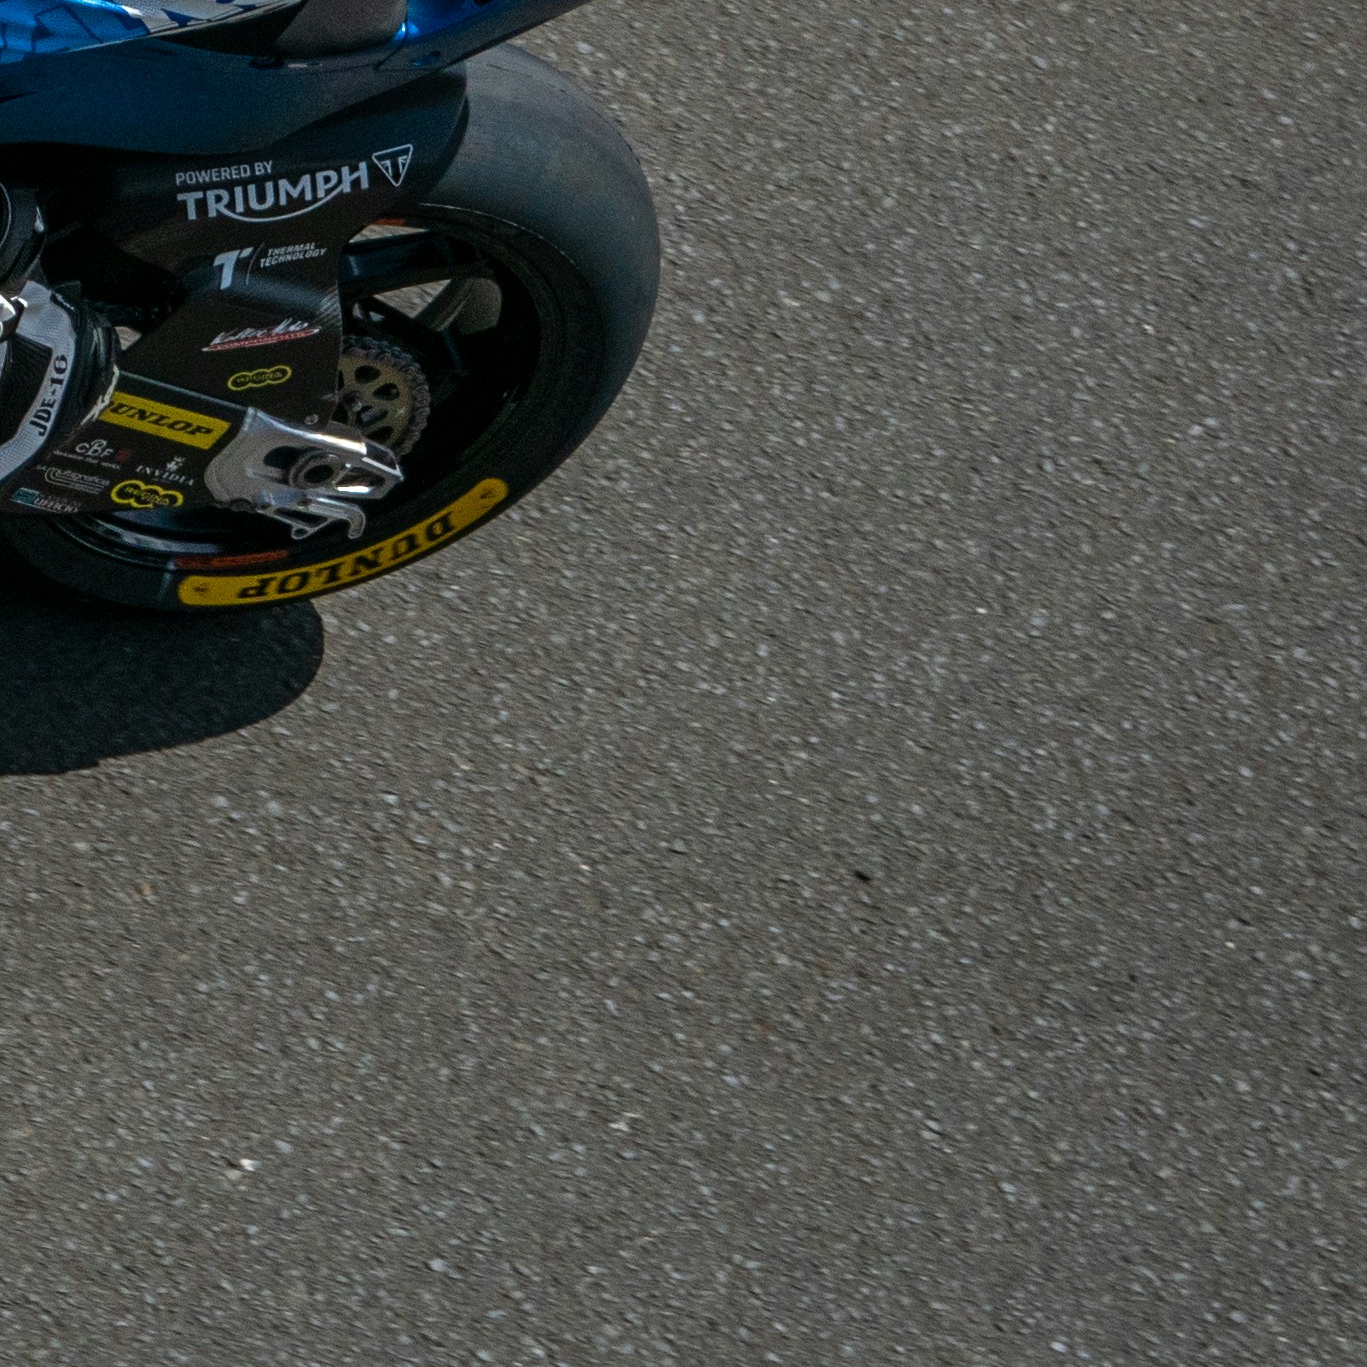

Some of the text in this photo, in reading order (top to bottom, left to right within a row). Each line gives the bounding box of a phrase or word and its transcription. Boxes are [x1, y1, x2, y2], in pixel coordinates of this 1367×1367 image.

[175, 160, 273, 186] POWERED BY
[176, 161, 369, 222] TRIUMPH
[260, 248, 327, 268] TECHNOLOGY
[267, 242, 315, 257] THERMAL
[108, 403, 214, 436] UNLOP
[237, 511, 455, 599] DUNLOP
